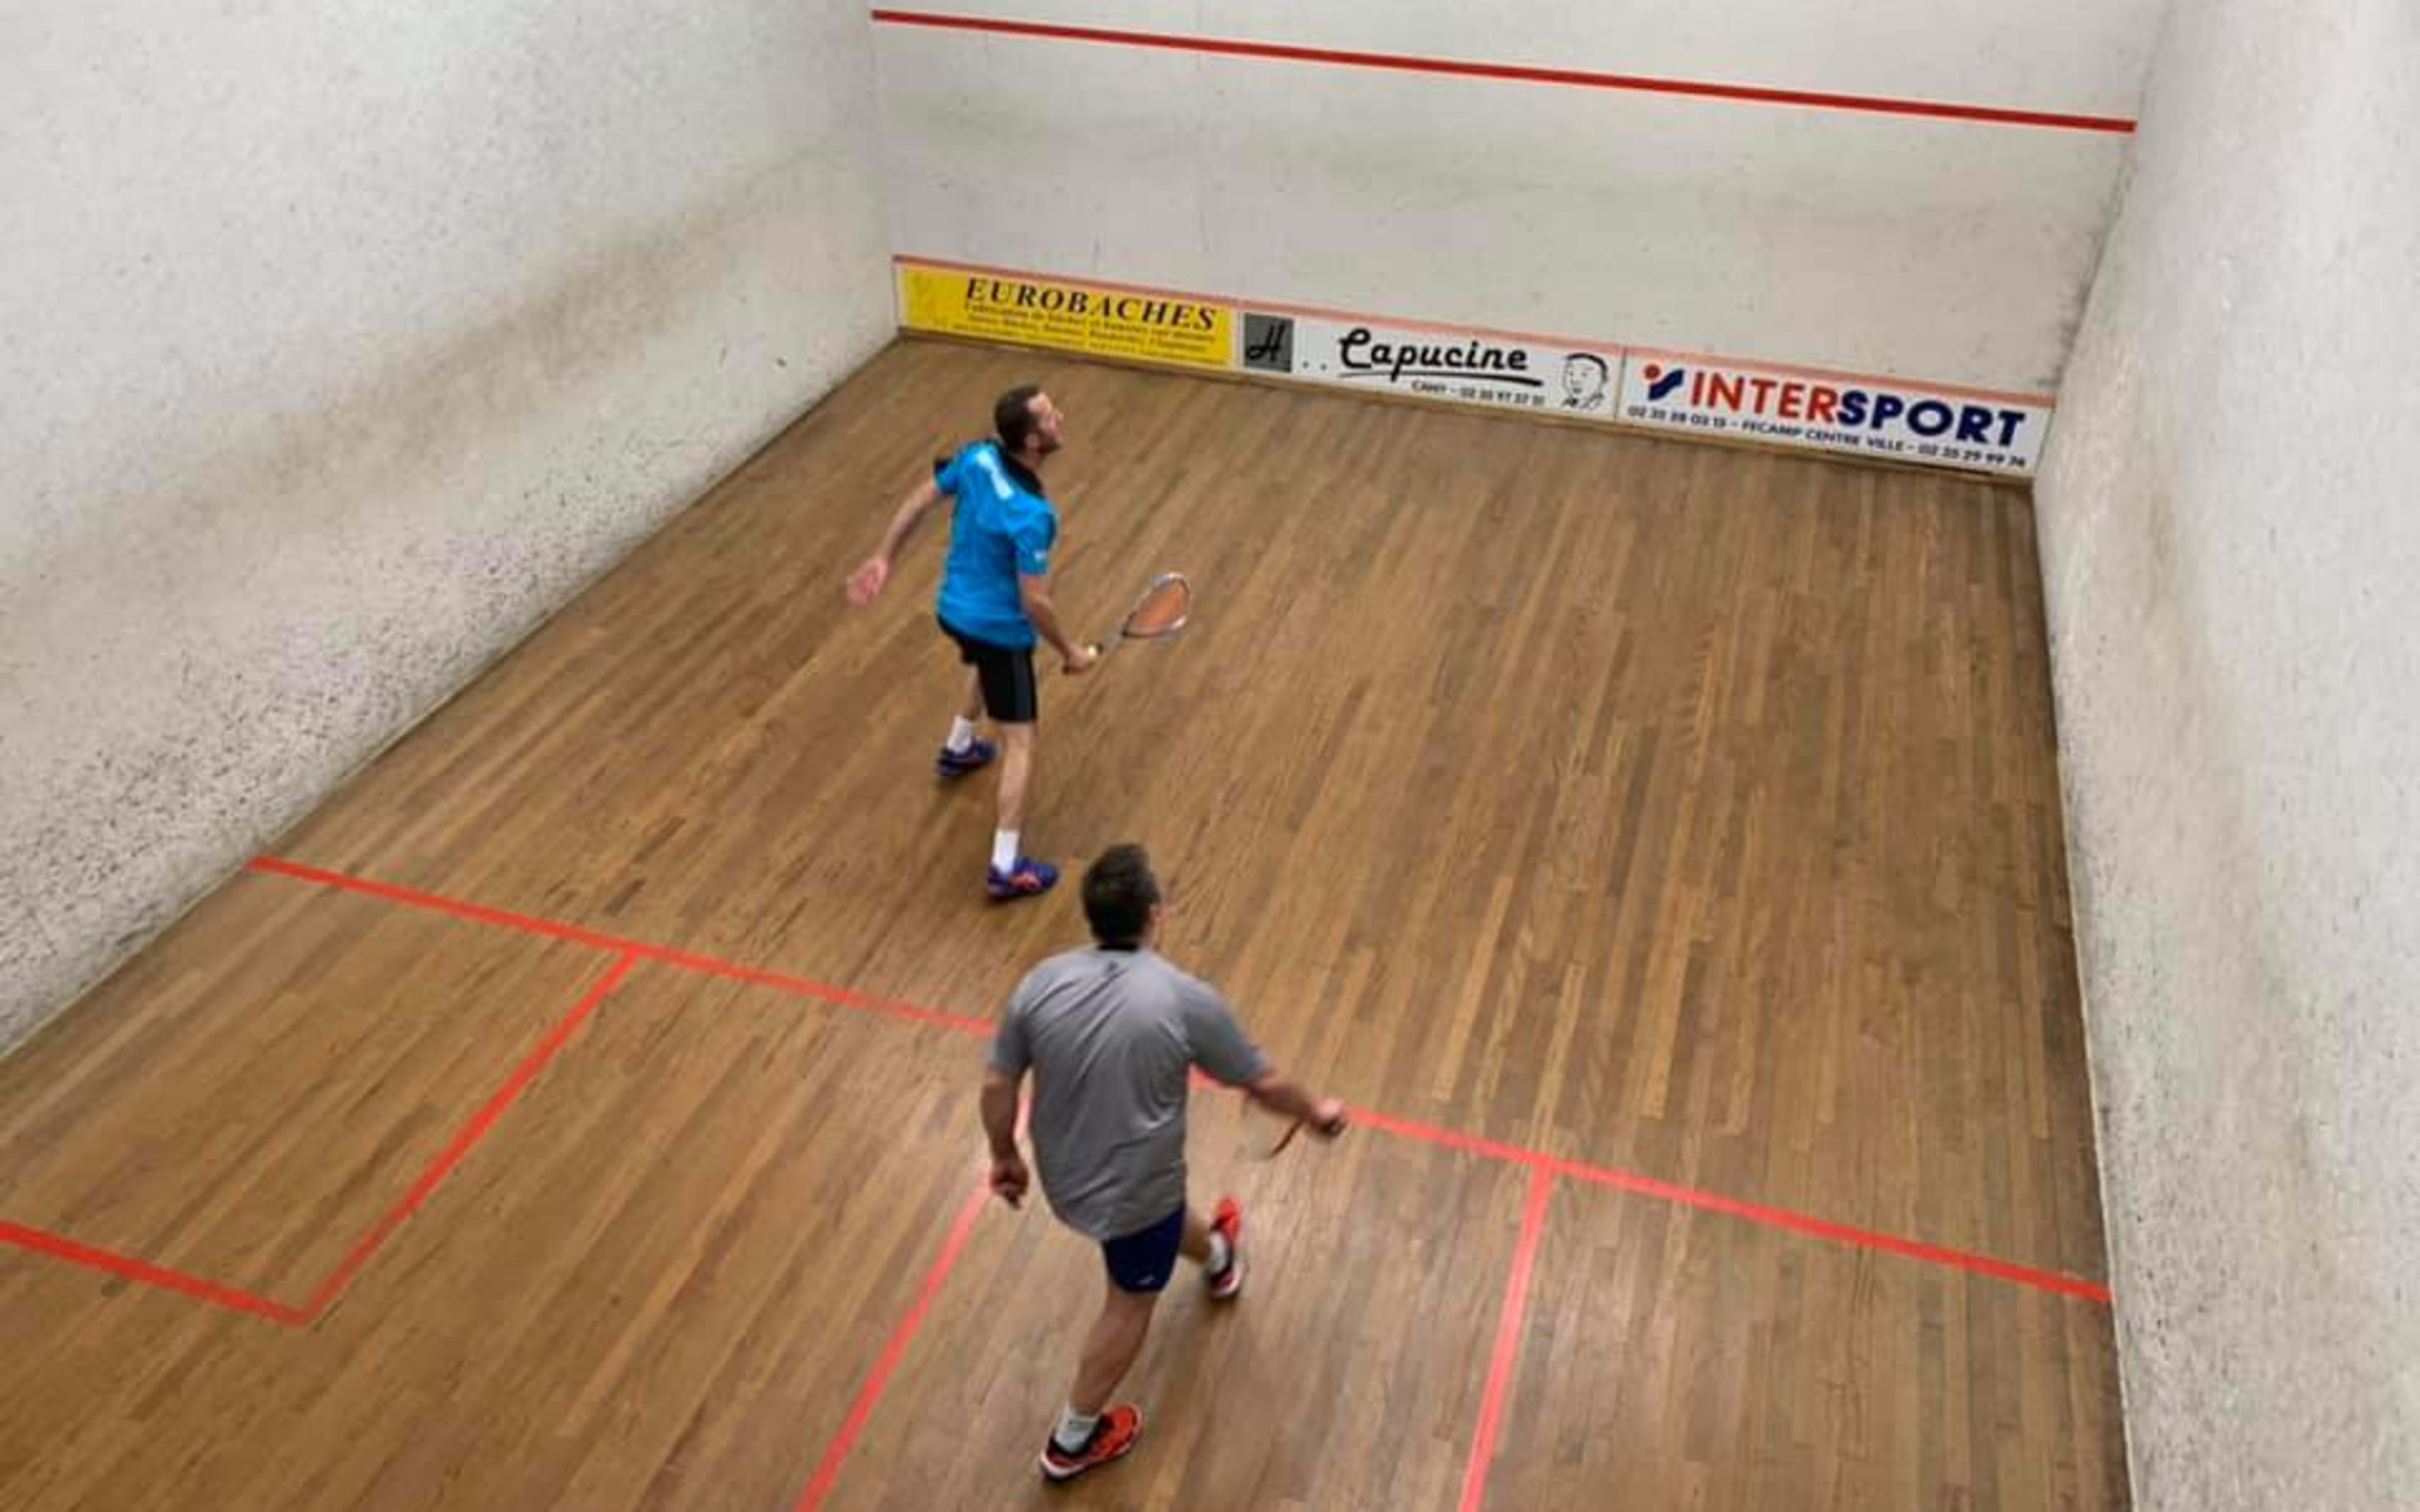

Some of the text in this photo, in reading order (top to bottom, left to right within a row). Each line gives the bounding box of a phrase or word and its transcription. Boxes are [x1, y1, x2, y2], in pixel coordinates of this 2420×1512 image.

[966, 277, 1217, 331] EUROBACHES
[1337, 328, 1529, 383] Capucine
[1627, 405, 1647, 418] 02
[1805, 430, 1860, 445] CENTRE
[1867, 435, 1903, 452] VILLE
[1691, 371, 2025, 447] INTERSPORT
